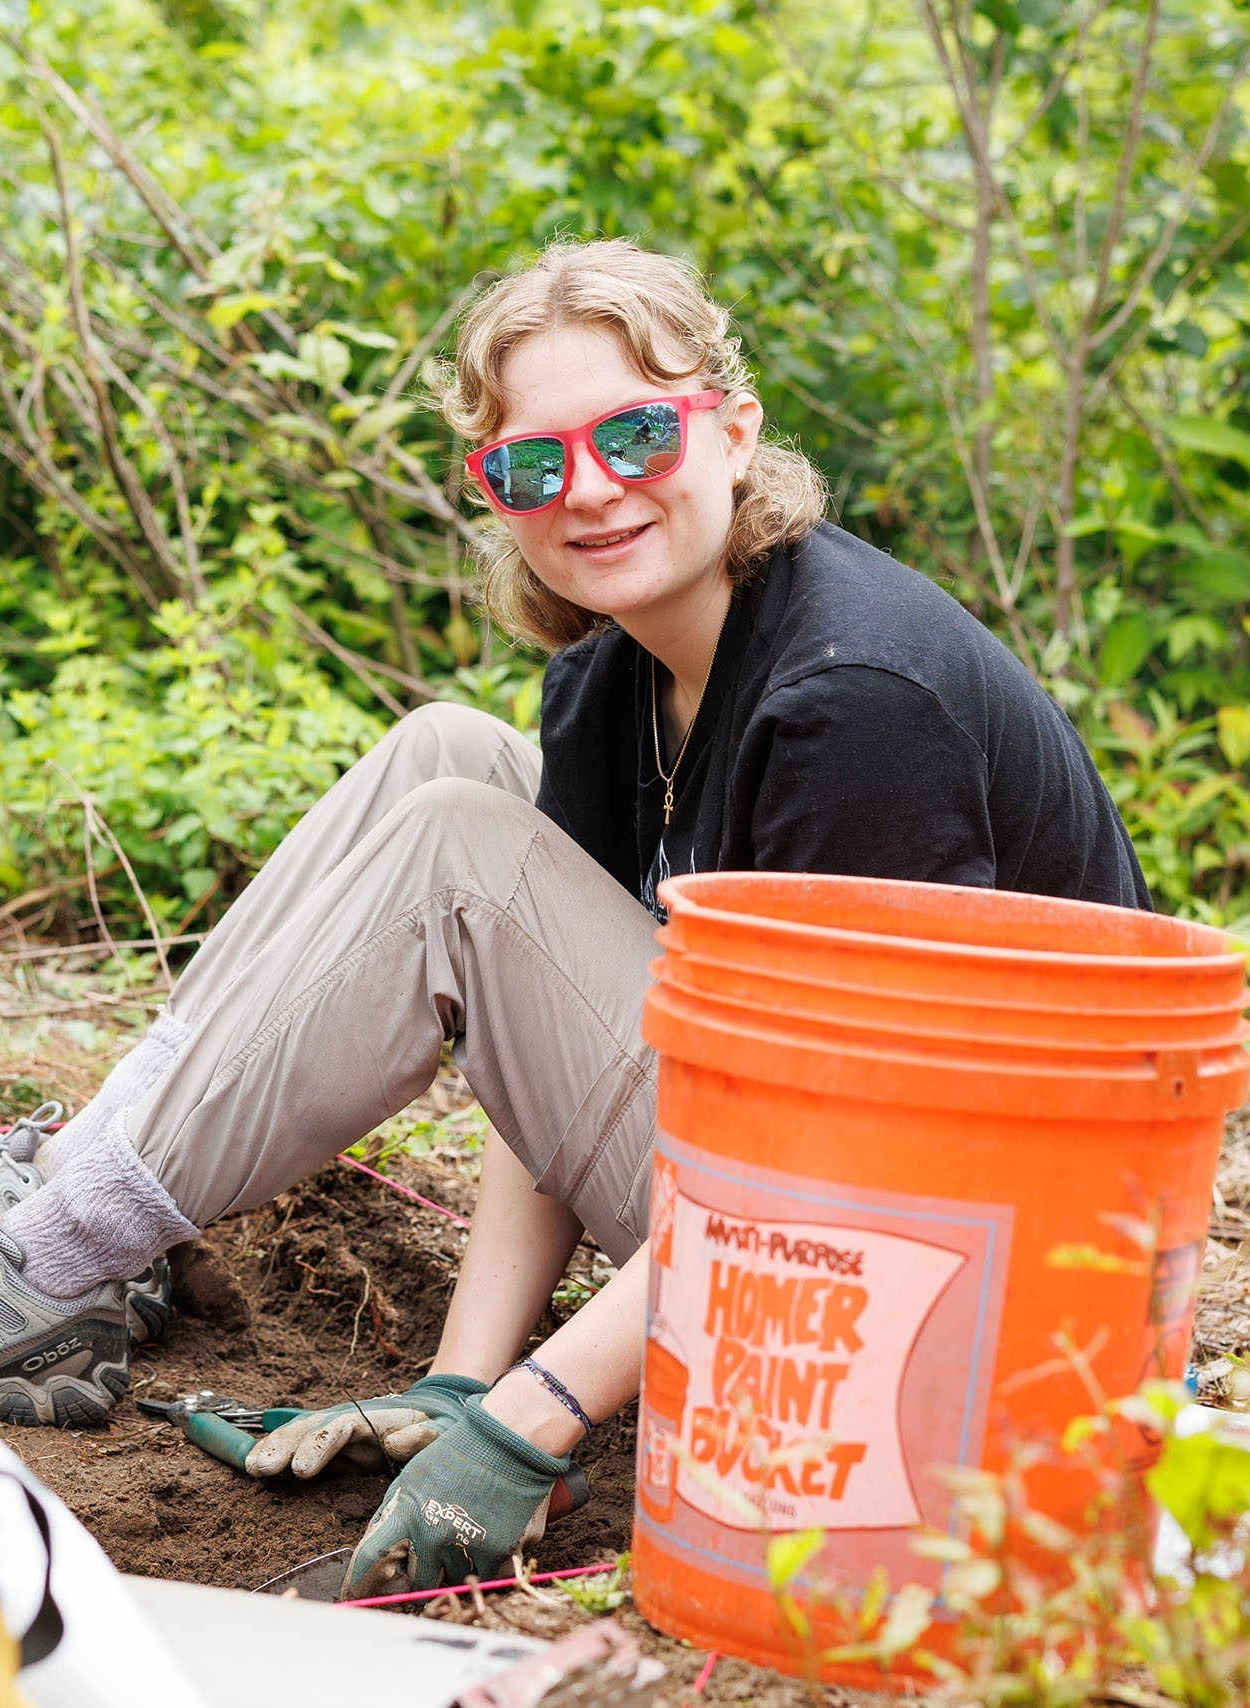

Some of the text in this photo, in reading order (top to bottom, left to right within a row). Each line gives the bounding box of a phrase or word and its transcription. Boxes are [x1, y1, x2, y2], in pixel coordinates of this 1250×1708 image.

[705, 1214, 865, 1277] MULTI-PURPOSE
[704, 1259, 869, 1355] HOMER
[712, 1335, 851, 1430] PAINT
[690, 1407, 867, 1501] BUCKET
[427, 1499, 482, 1539] EXPERT
